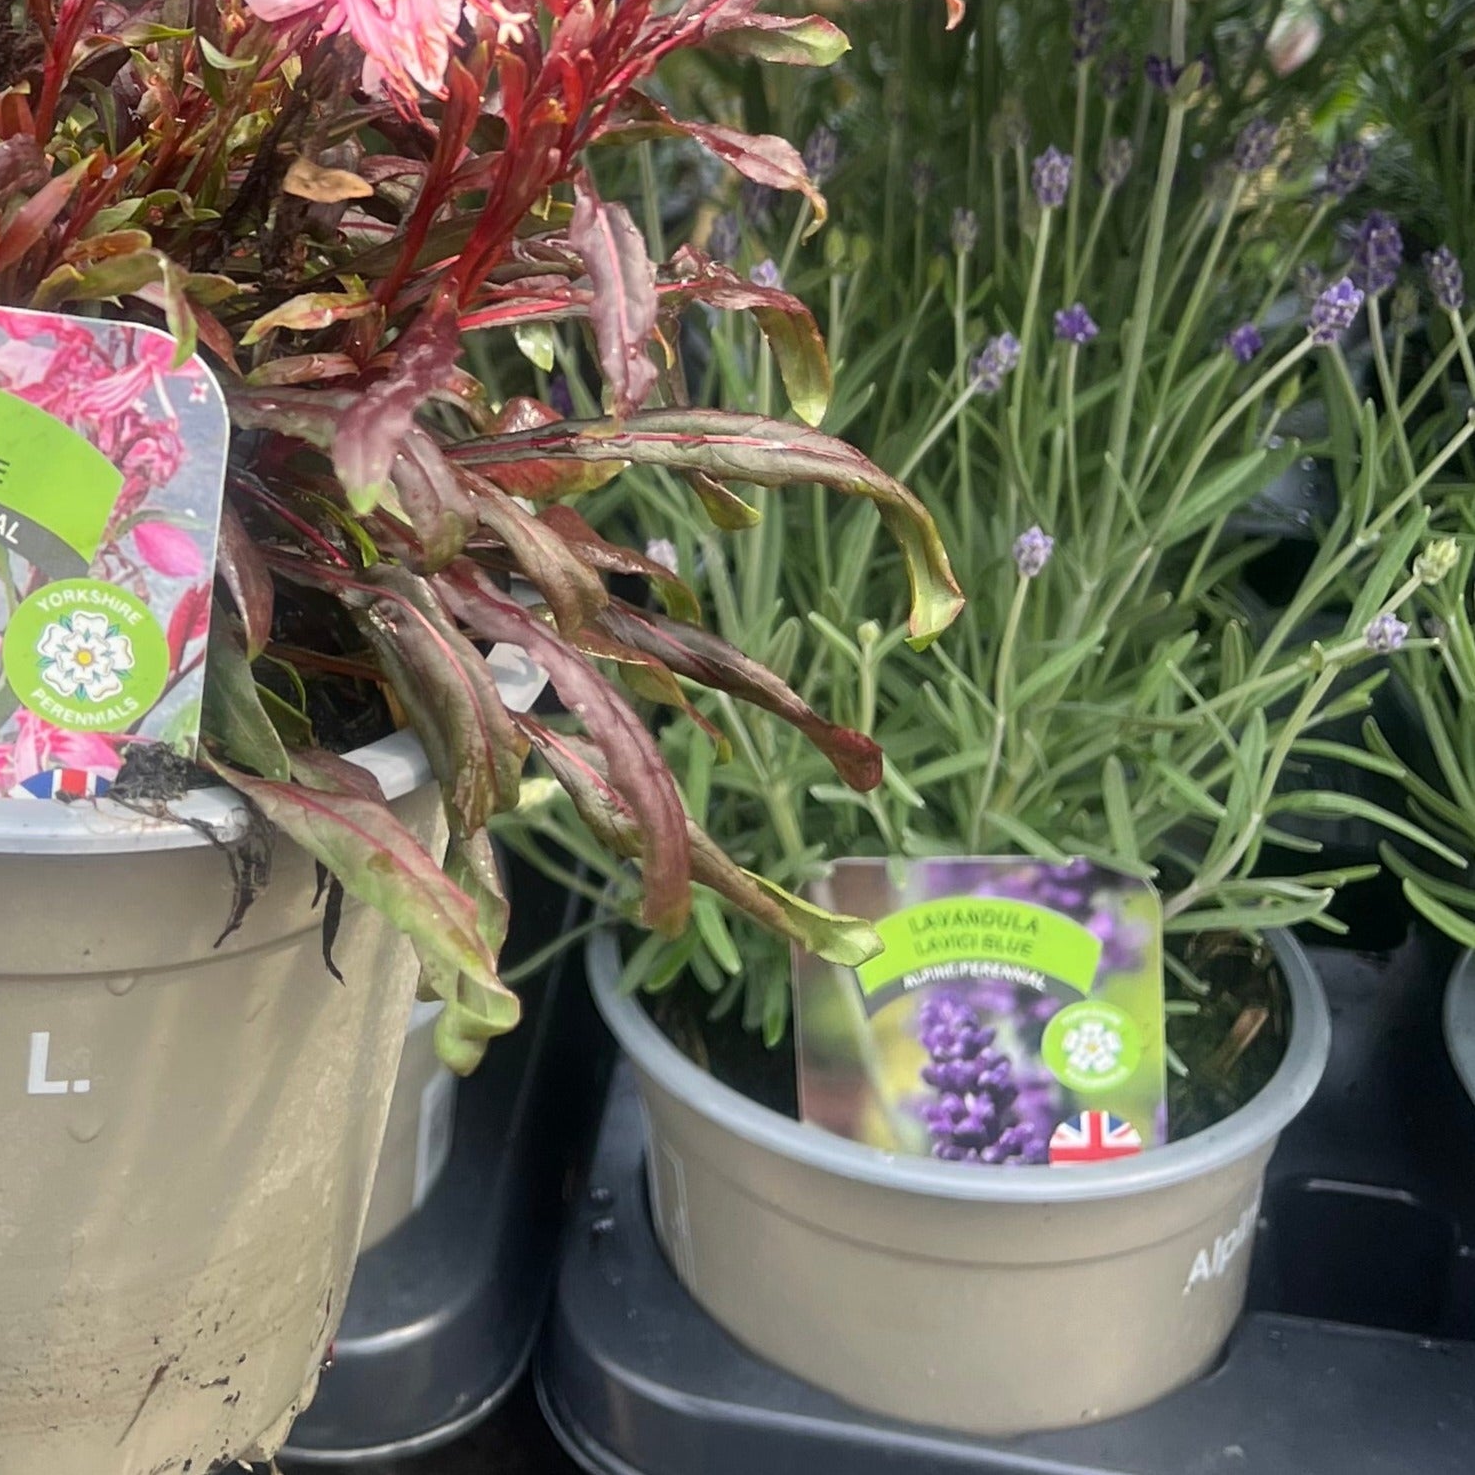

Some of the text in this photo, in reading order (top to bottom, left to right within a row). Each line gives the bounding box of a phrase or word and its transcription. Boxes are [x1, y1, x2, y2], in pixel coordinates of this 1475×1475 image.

[35, 588, 144, 626] YORKSHIRE
[30, 687, 140, 726] PERENNIALS
[908, 909, 1040, 936] LAVANDULA
[982, 934, 1035, 958] BLUE
[27, 1031, 91, 1095] L.
